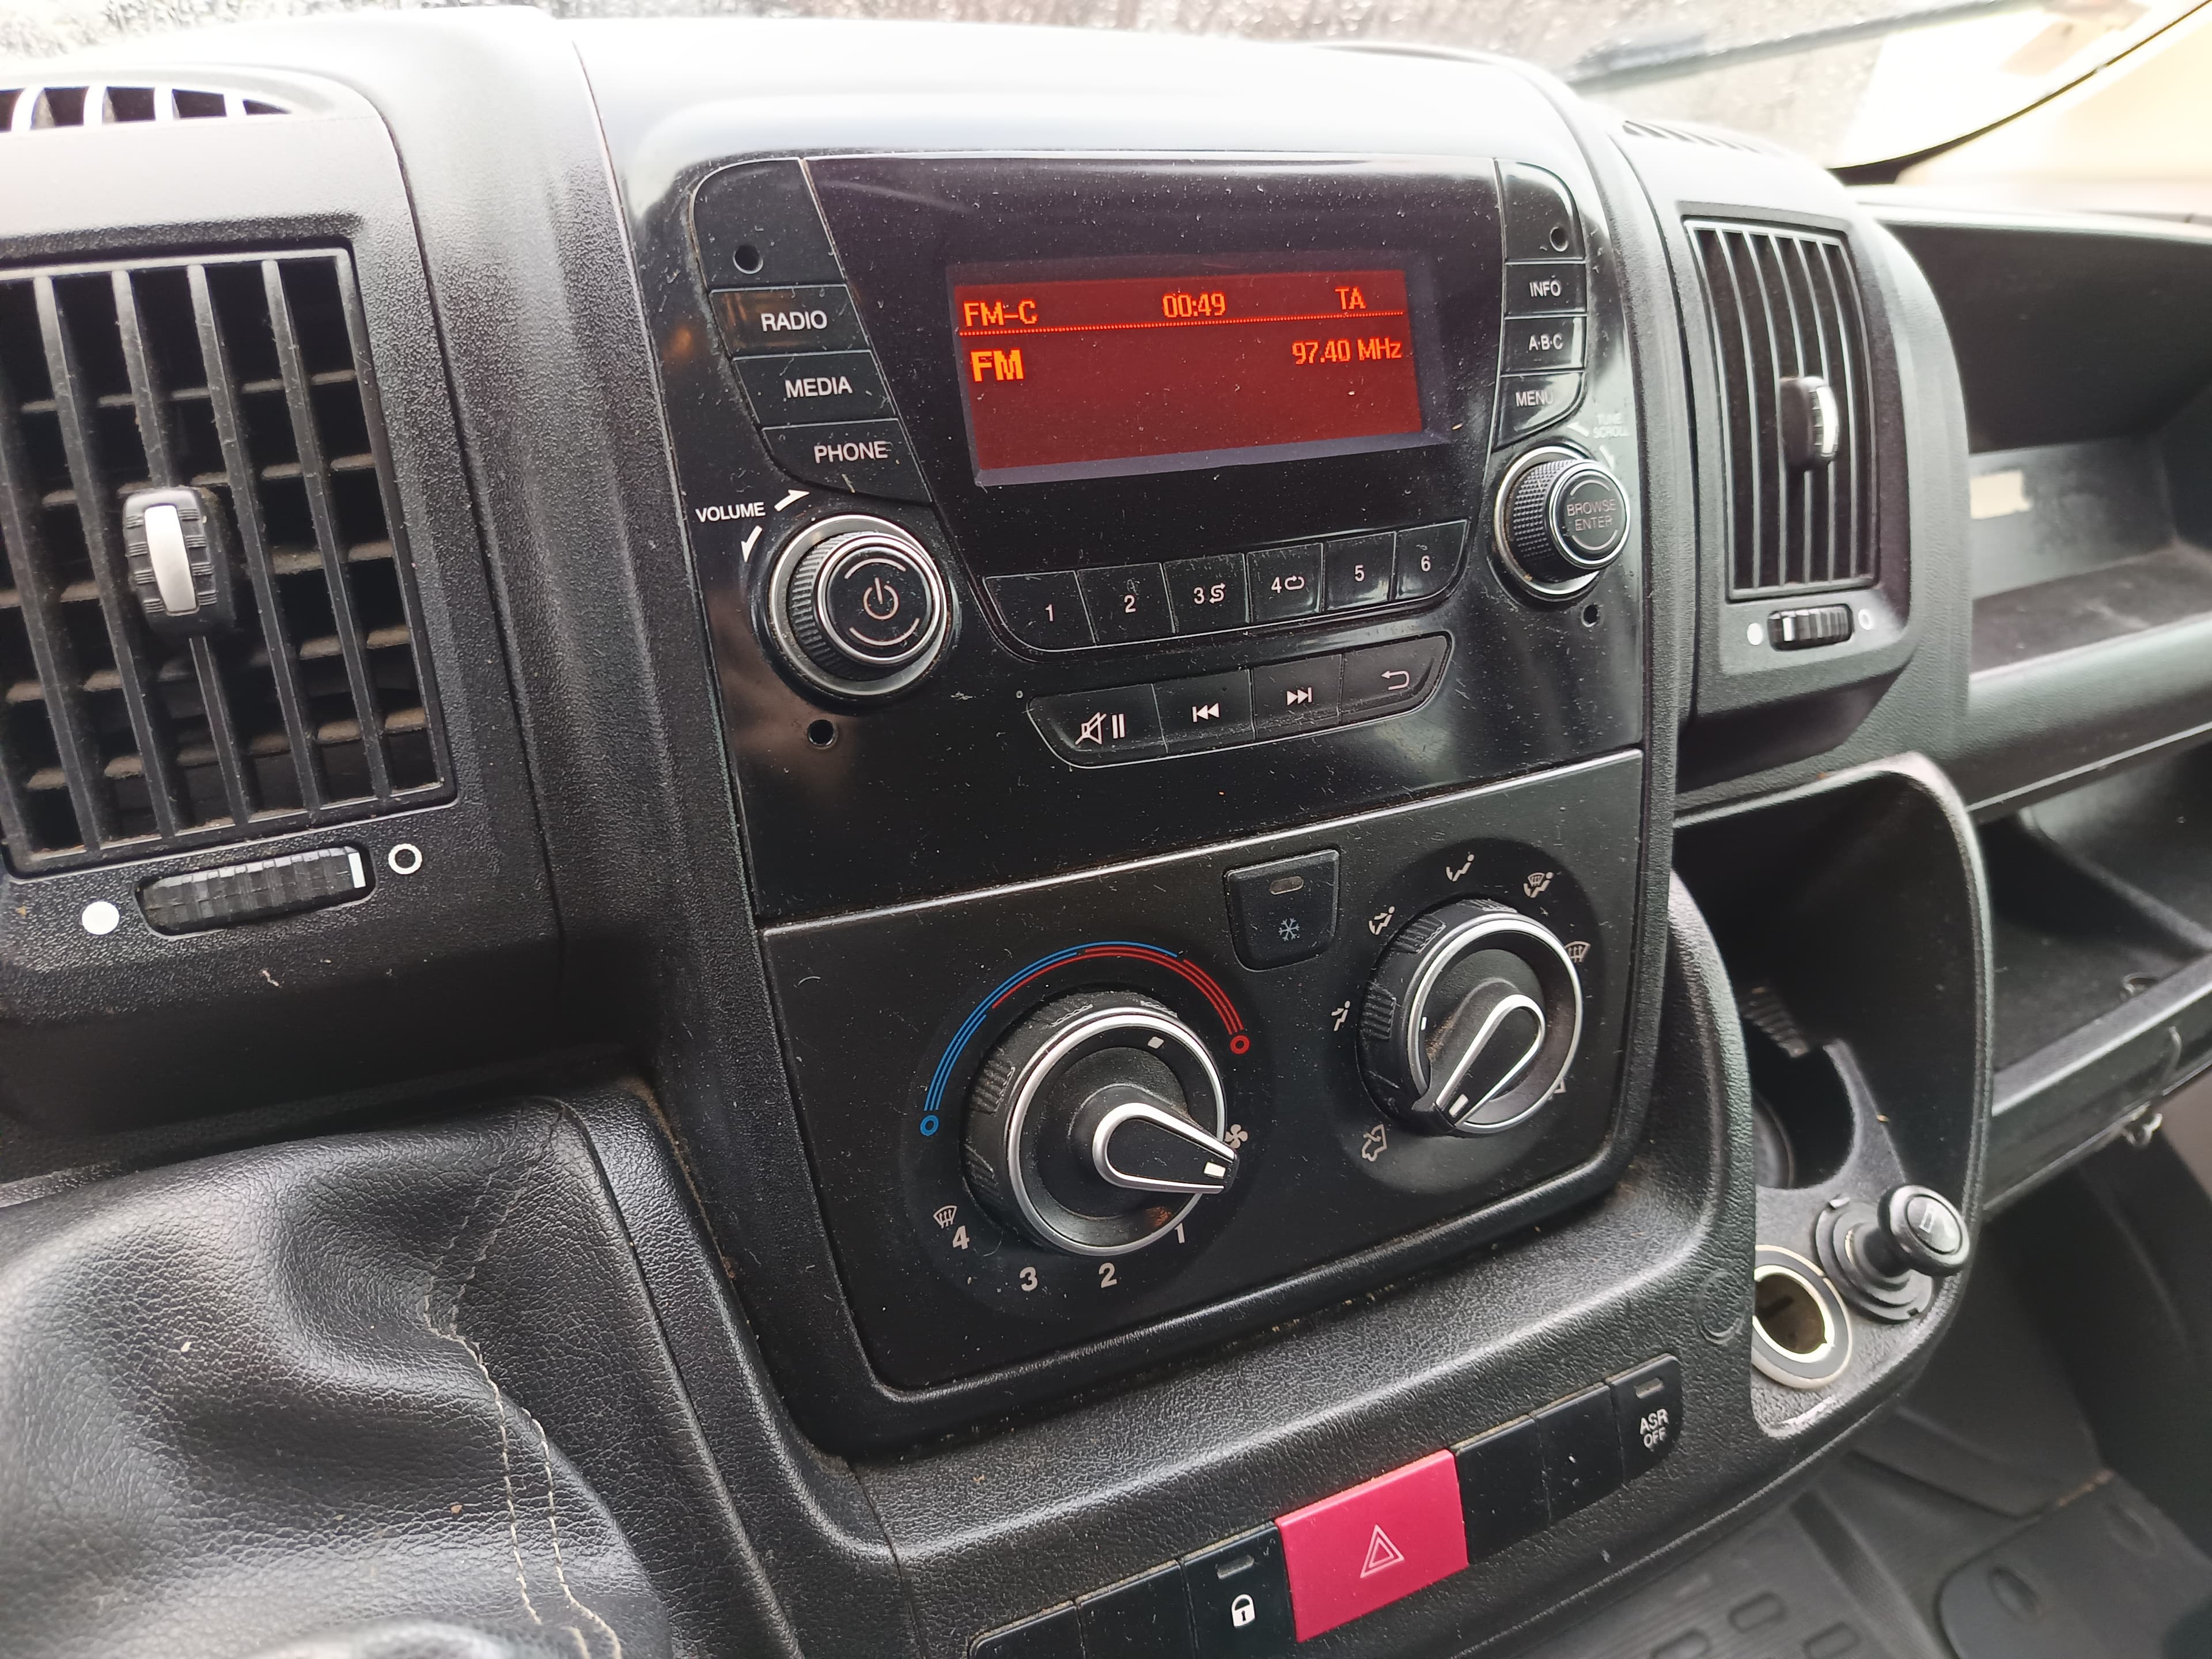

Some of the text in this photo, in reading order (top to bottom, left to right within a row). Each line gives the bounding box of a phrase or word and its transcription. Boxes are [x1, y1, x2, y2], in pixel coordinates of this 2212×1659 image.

[1529, 280, 1562, 297] INFO
[964, 287, 1367, 327] FM-C 00:49 TA
[760, 309, 828, 332] RADIO
[971, 338, 1402, 382] FM 97.40 MHz
[785, 375, 853, 399] MEDIA
[1516, 391, 1554, 407] MENU
[1593, 426, 1631, 438] SCROLL
[814, 441, 888, 463] PHONE
[695, 502, 766, 524] VOLUME
[1566, 499, 1617, 517] BROWSE
[1574, 515, 1613, 531] ENTER
[1354, 565, 1365, 582] 5
[1421, 555, 1431, 572] 6
[1194, 587, 1205, 604] 3
[1271, 577, 1283, 594] 4
[1046, 604, 1055, 621] 1
[1124, 595, 1137, 613] 2
[952, 1225, 970, 1250] 4
[1175, 1223, 1185, 1243] 1
[1019, 1267, 1038, 1291] 3
[1098, 1262, 1118, 1289] 2
[1639, 1408, 1669, 1434] ASR
[1643, 1427, 1668, 1449] OFF
